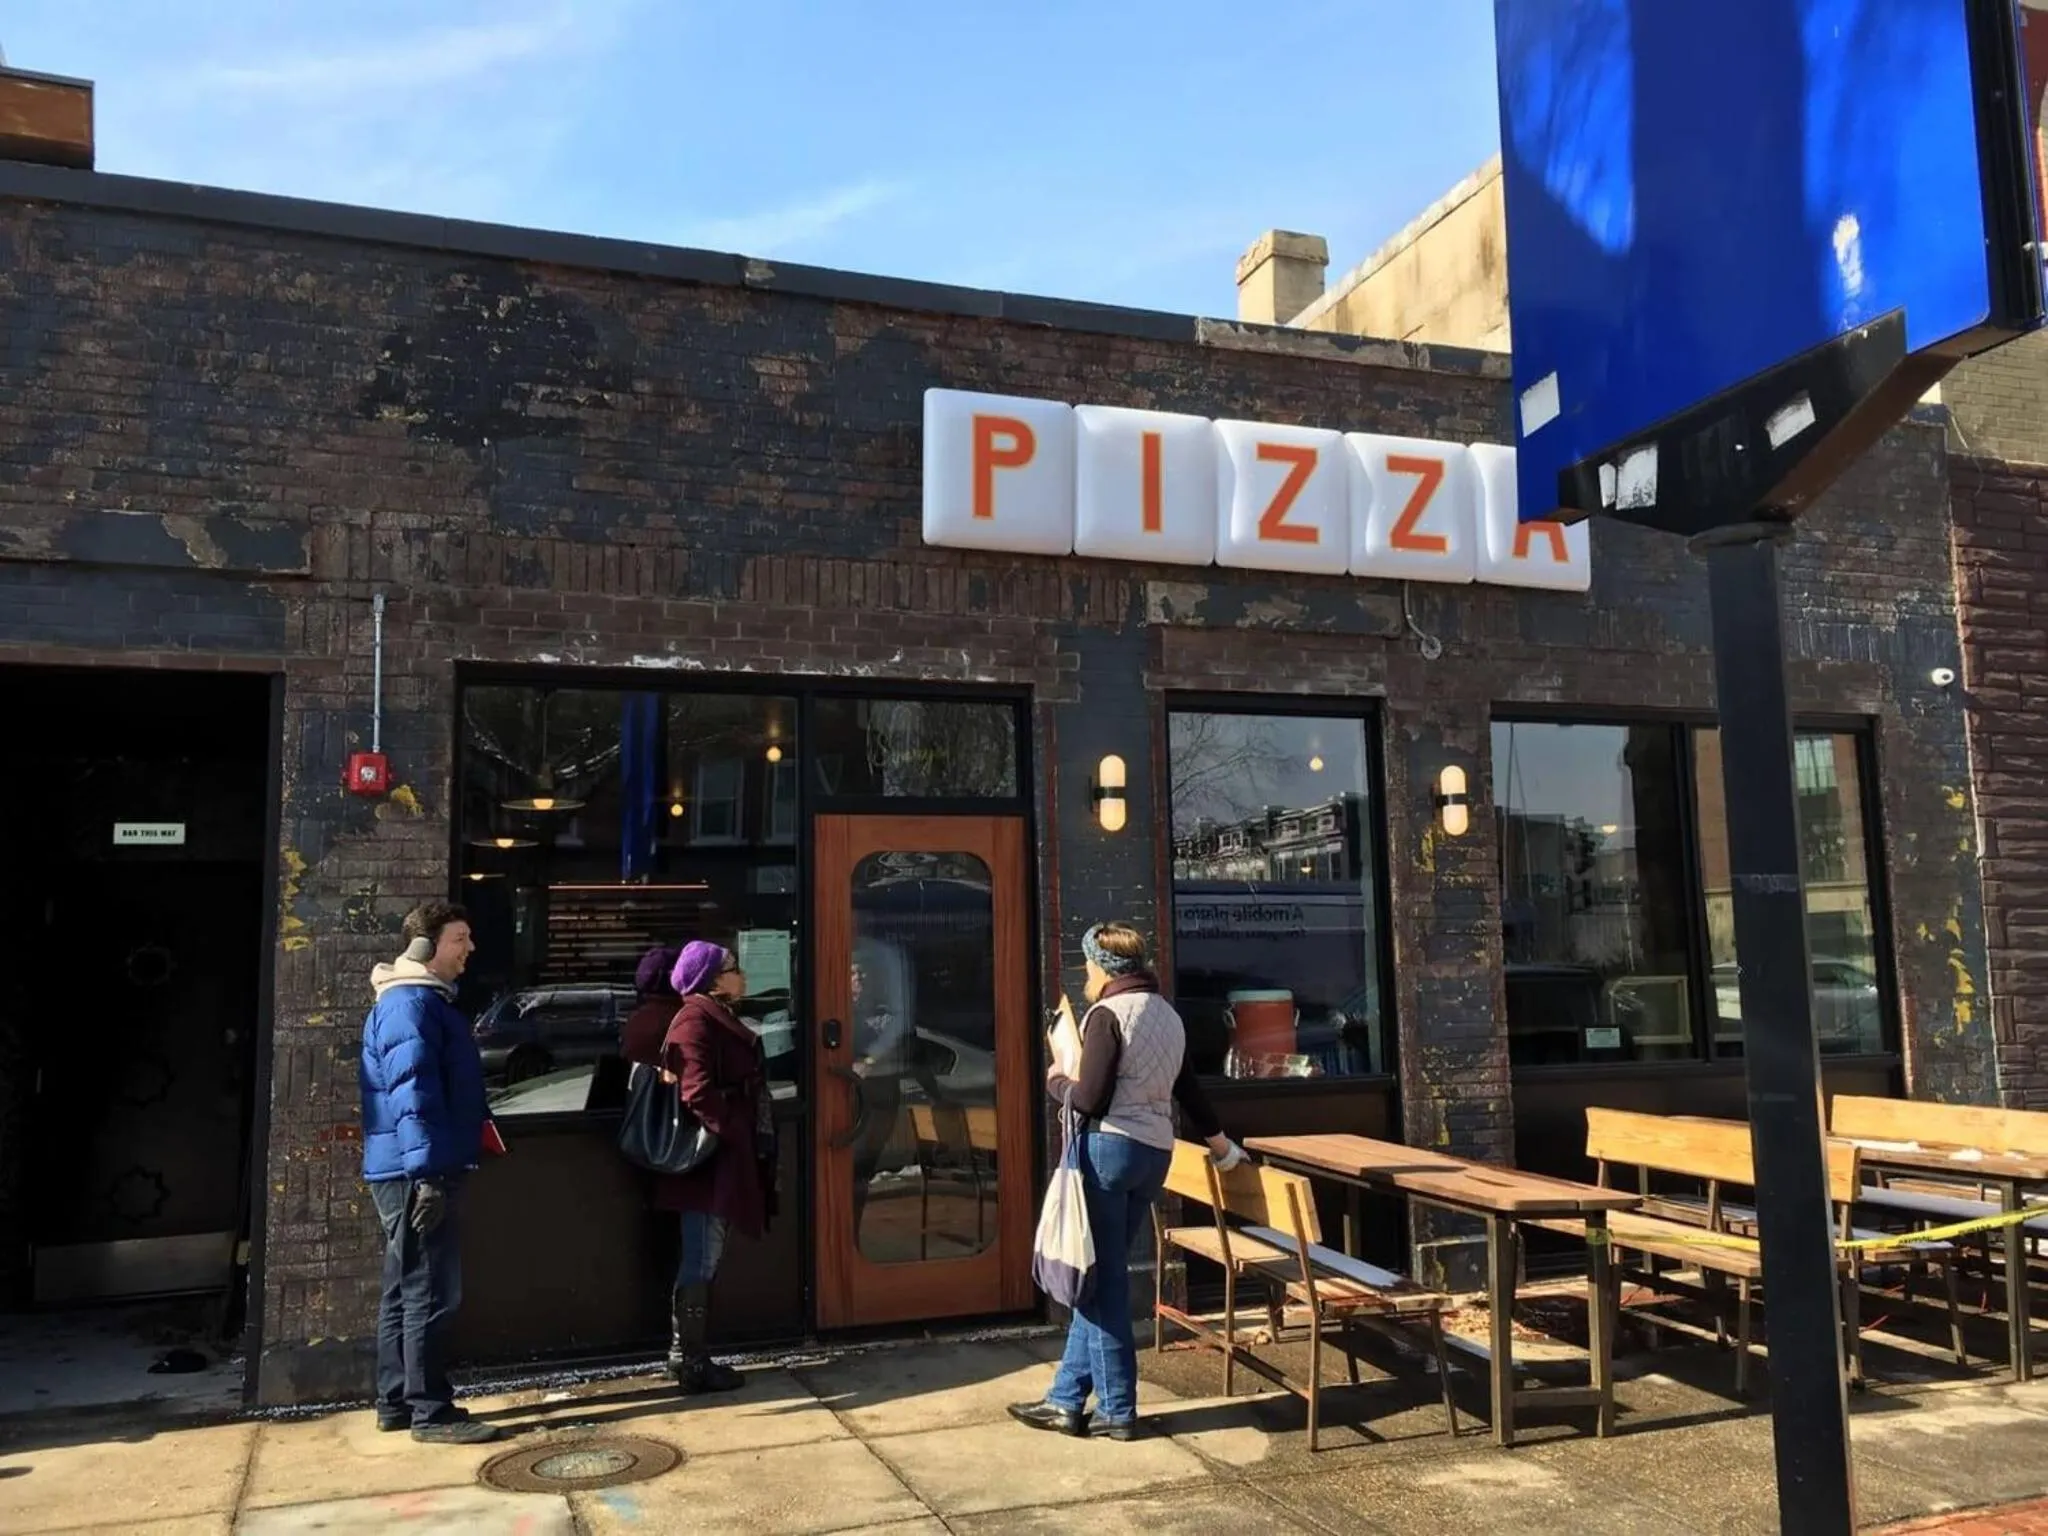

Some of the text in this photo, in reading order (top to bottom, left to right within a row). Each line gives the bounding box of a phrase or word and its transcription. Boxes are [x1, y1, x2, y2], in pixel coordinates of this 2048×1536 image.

[122, 829, 176, 837] BAR THIS WAY
